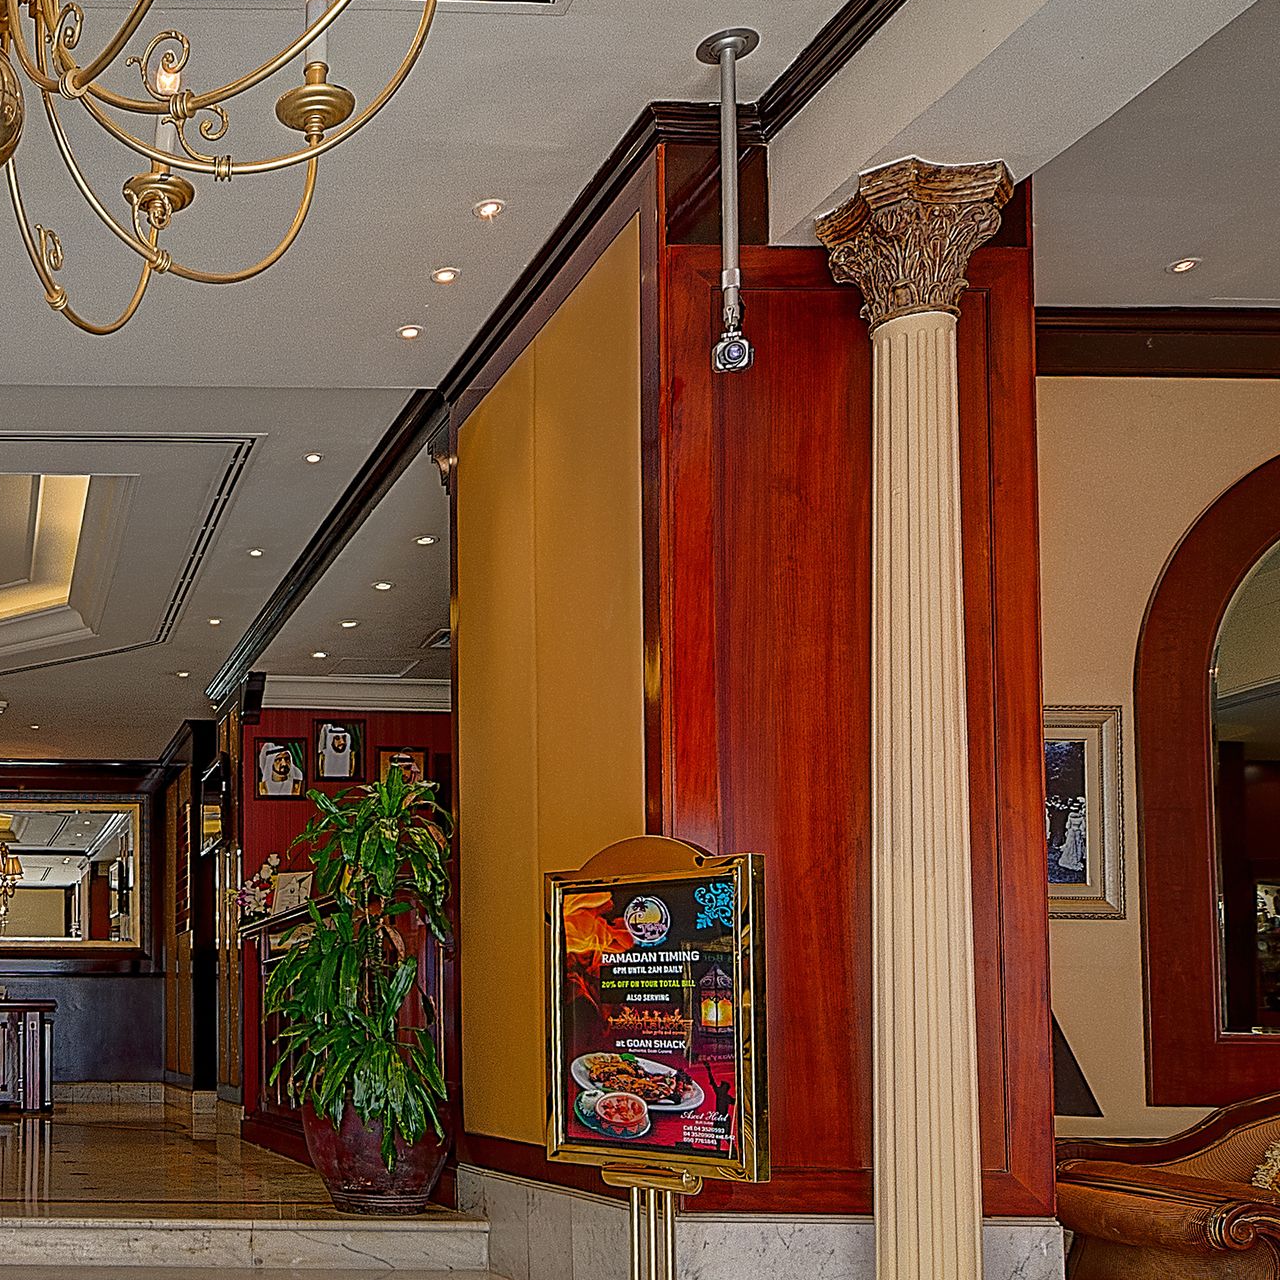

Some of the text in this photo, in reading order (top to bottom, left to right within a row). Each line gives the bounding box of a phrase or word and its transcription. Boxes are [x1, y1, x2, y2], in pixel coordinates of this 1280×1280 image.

[602, 951, 700, 964] RAMADAN TIMING
[627, 966, 647, 974] UNTIL
[647, 966, 663, 974] 2AM
[663, 965, 683, 973] DAILY
[640, 980, 658, 988] YOUR
[626, 1039, 652, 1048] GOAN
[653, 1040, 686, 1049] SHACK
